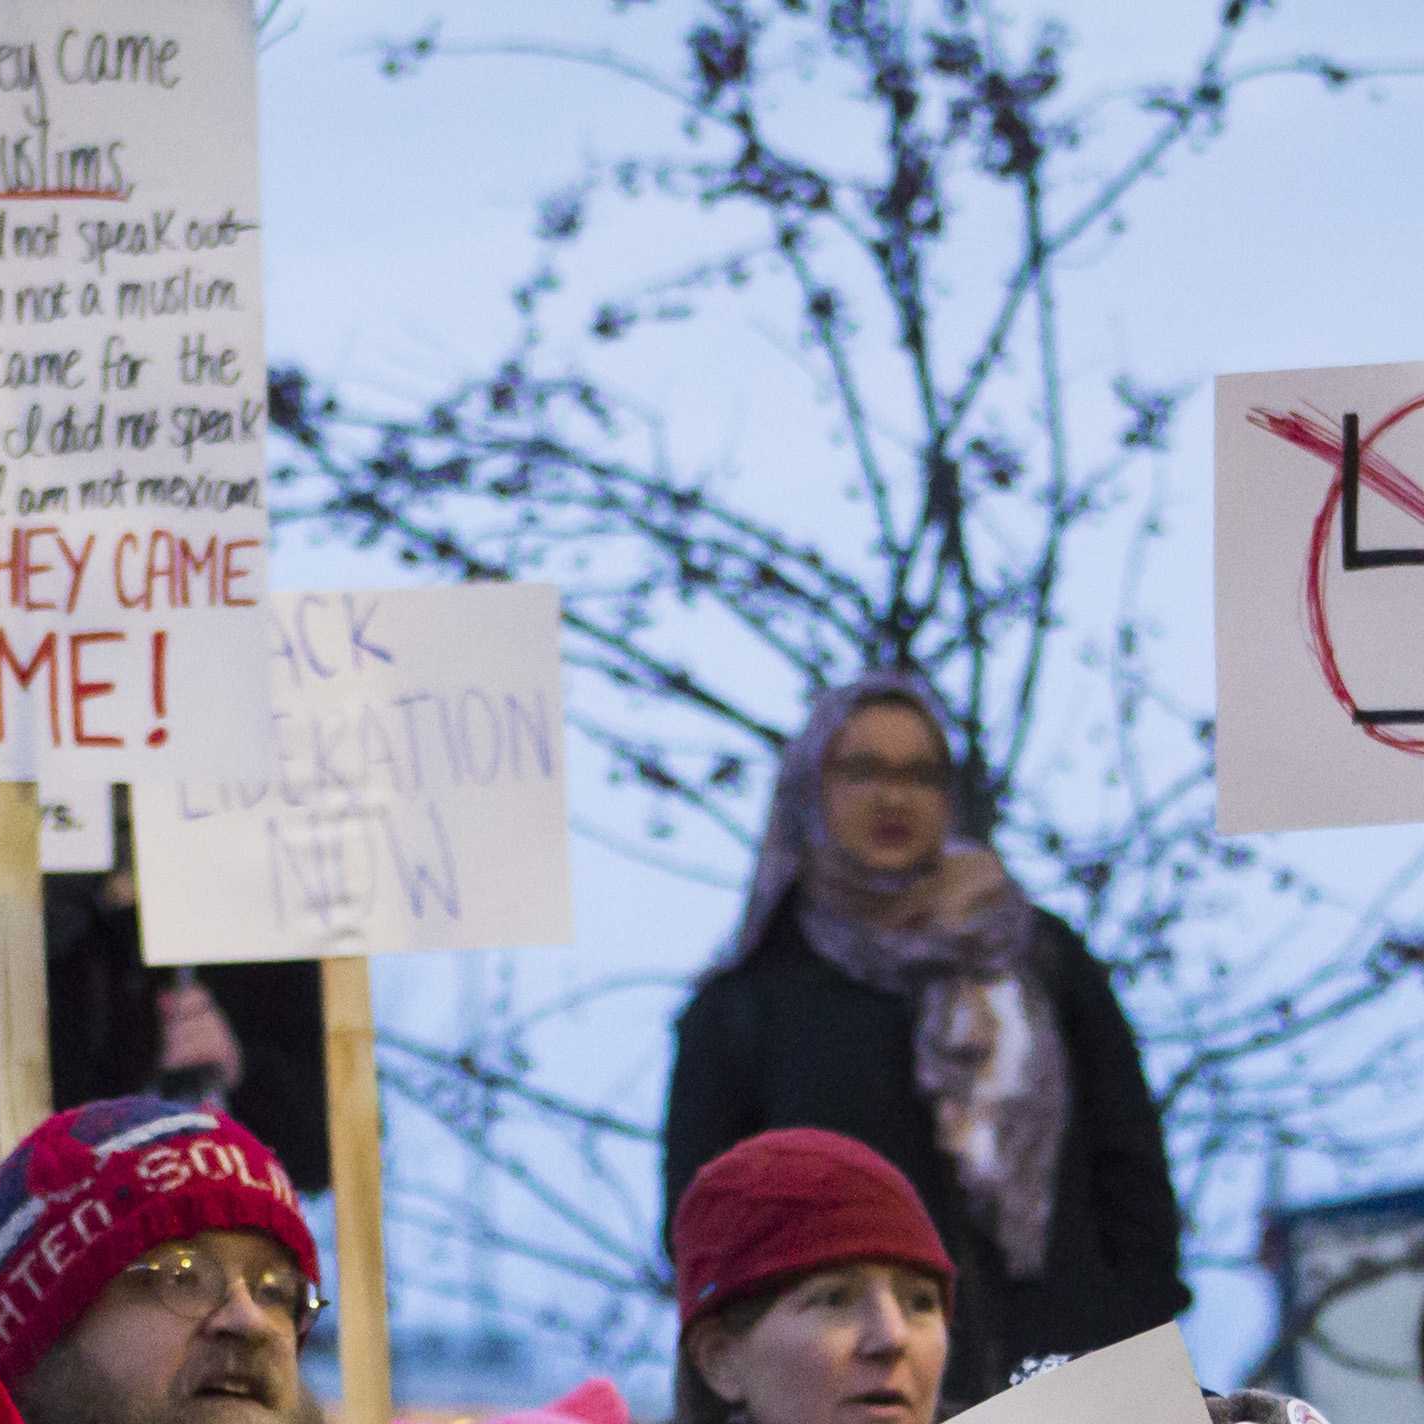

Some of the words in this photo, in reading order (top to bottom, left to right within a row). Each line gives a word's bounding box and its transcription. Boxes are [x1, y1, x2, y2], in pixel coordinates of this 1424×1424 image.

[56, 27, 180, 89] came
[13, 211, 61, 259] not
[78, 209, 176, 273] speak
[16, 283, 72, 324] not
[78, 282, 102, 317] a
[118, 268, 244, 324] muslim
[98, 333, 151, 393] for
[177, 333, 241, 387] the
[4, 402, 46, 459] I
[47, 402, 105, 454] did
[117, 407, 158, 450] not
[171, 397, 263, 463] speak
[17, 485, 68, 515] am
[77, 470, 129, 511] not
[136, 472, 263, 511] mexican
[113, 529, 262, 611] CAME
